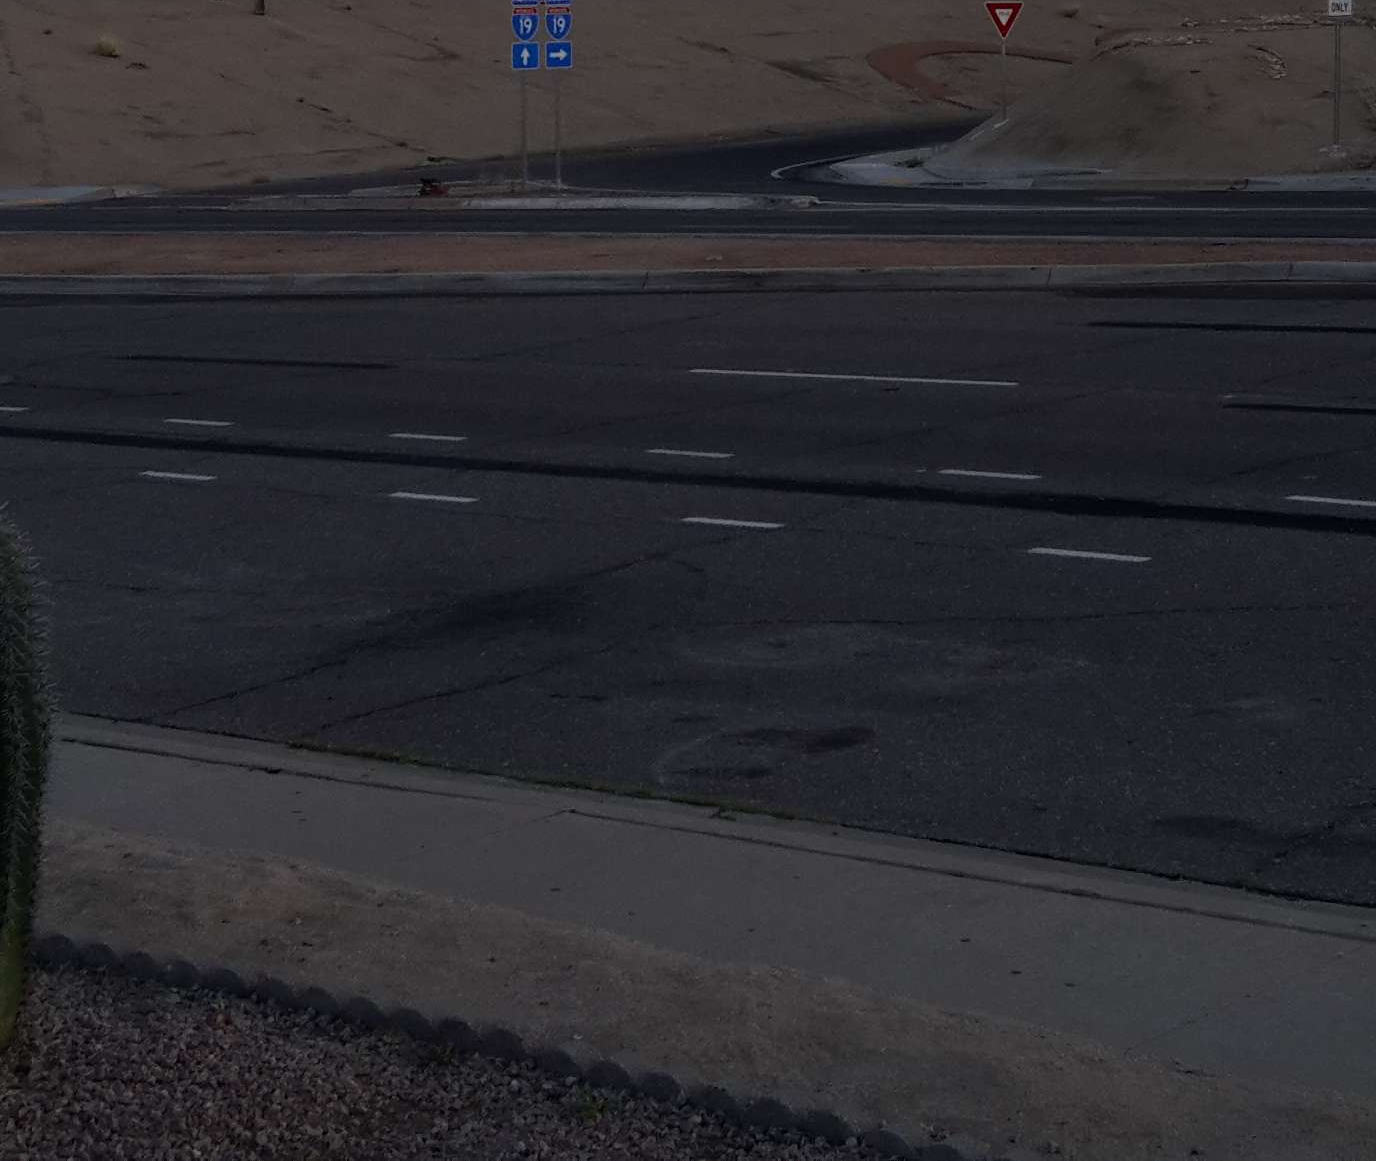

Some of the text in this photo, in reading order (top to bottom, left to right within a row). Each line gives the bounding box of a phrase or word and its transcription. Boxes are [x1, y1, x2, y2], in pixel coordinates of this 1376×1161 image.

[1331, 2, 1348, 12] ONLY
[519, 18, 533, 35] 19
[553, 16, 566, 35] 19
